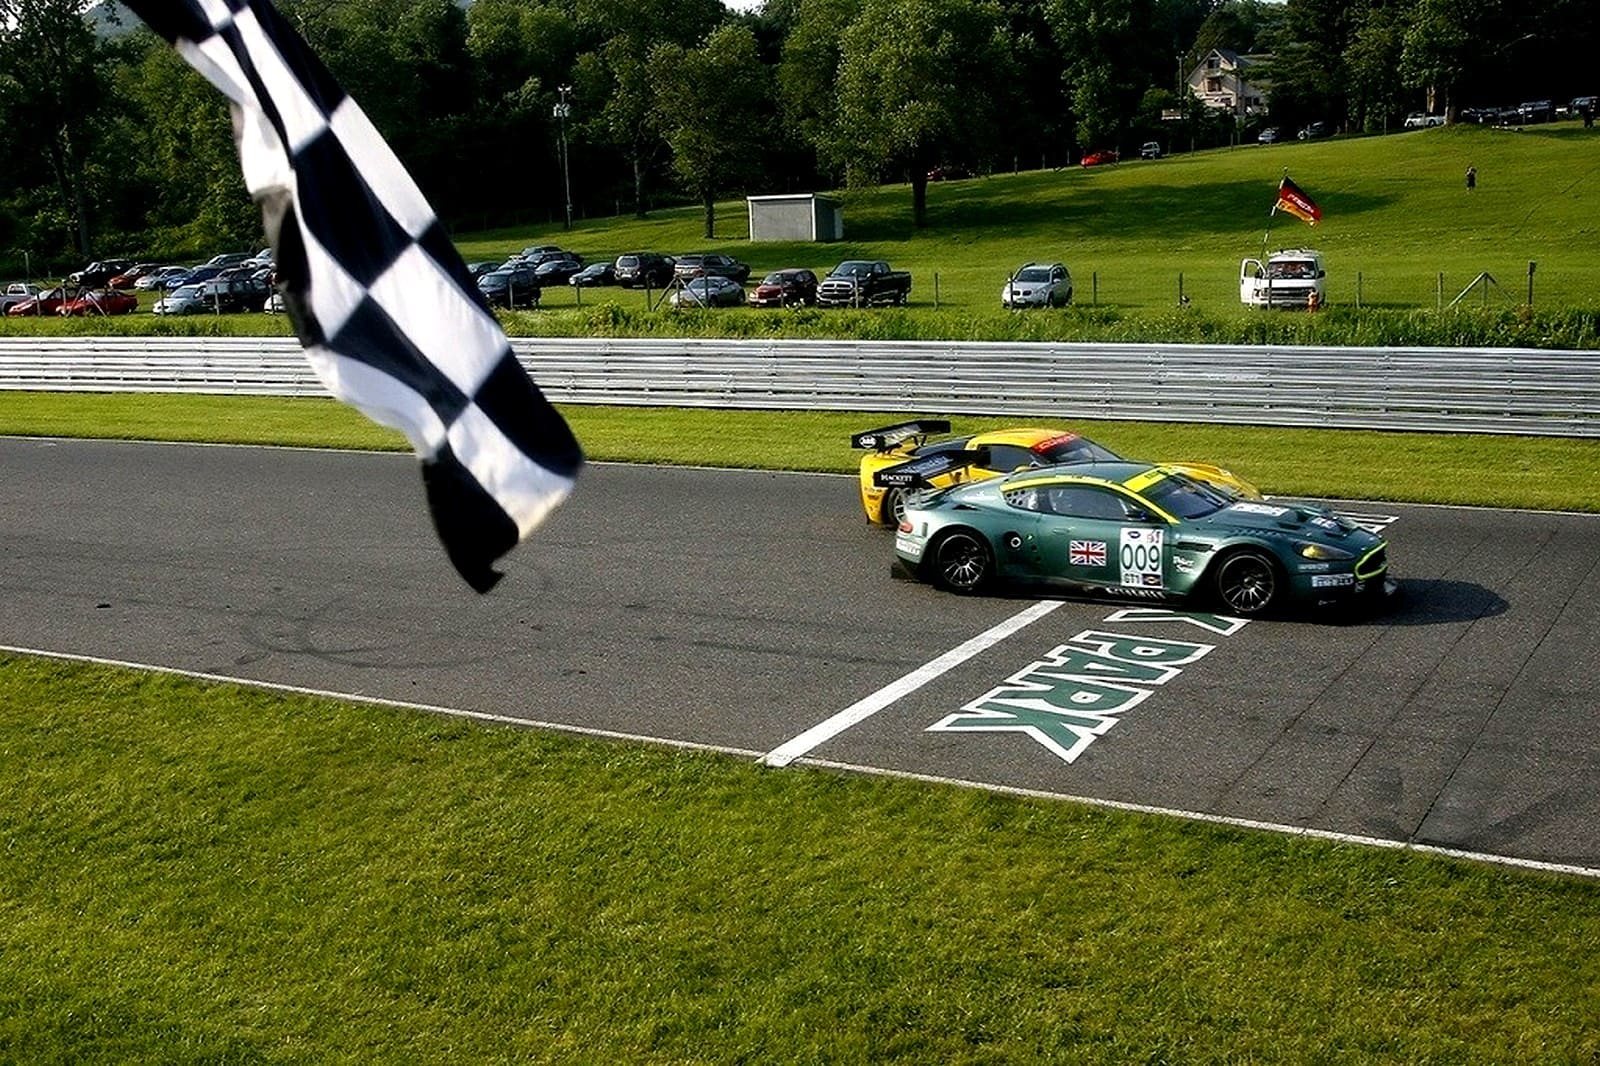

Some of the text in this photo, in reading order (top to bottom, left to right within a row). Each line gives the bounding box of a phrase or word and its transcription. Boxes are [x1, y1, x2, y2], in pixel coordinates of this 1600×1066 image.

[880, 473, 913, 482] HACKETT
[1121, 543, 1161, 572] 009
[1124, 573, 1141, 584] GT1
[923, 629, 1218, 765] PARK
